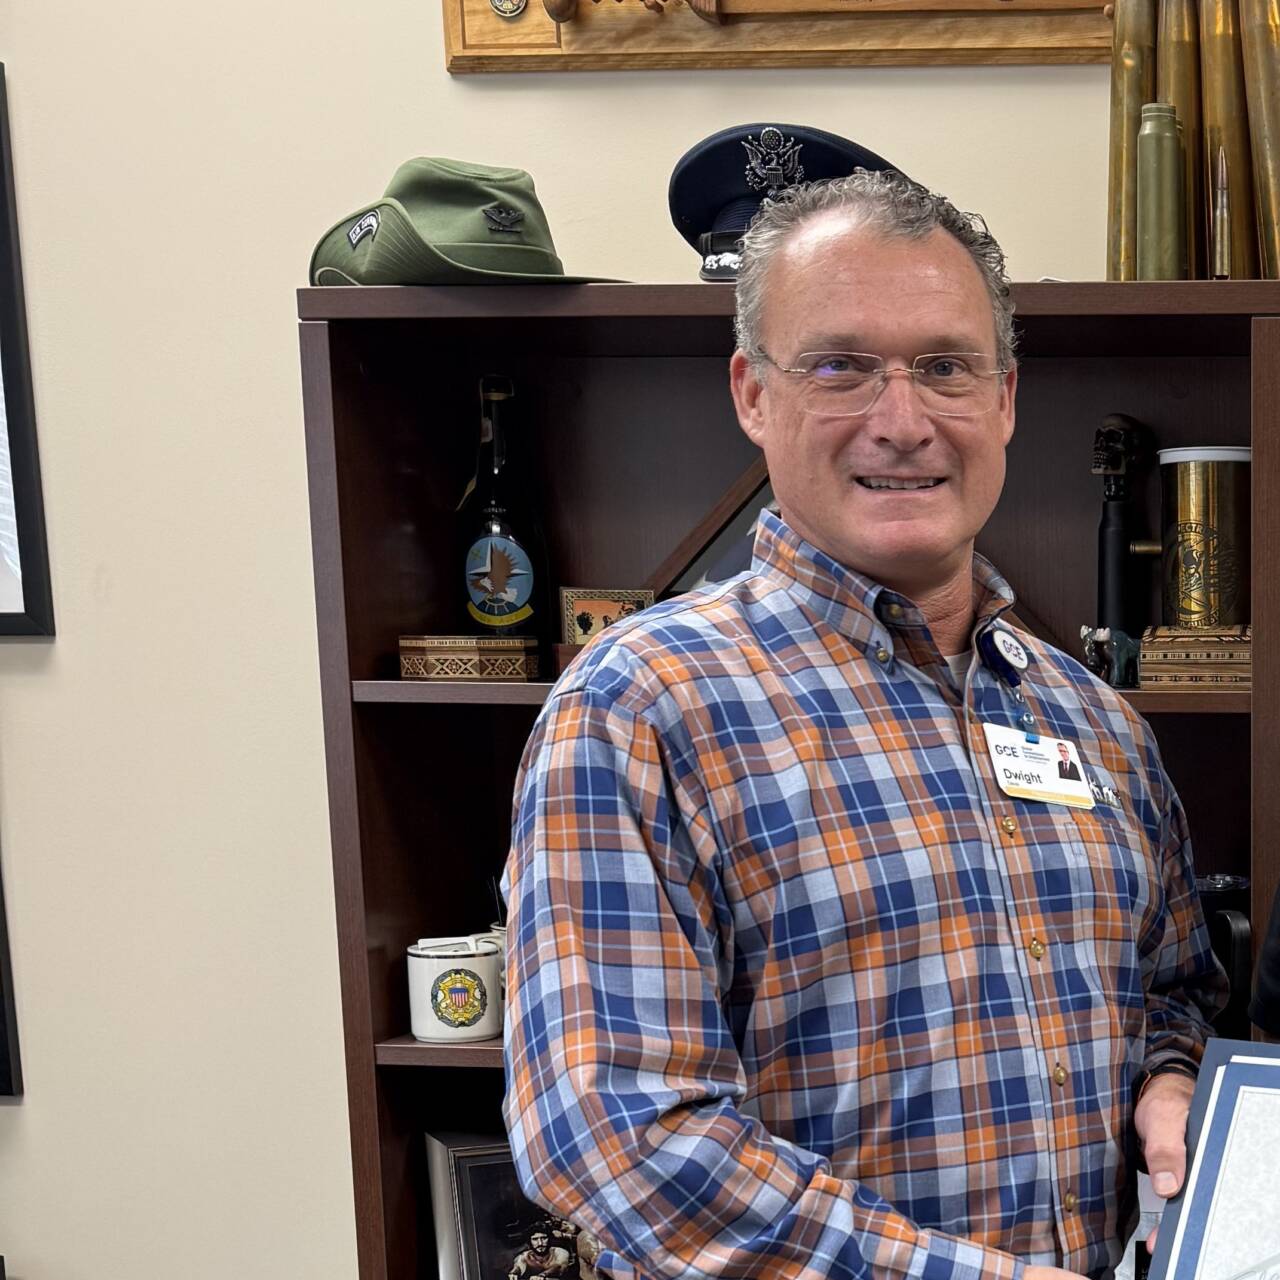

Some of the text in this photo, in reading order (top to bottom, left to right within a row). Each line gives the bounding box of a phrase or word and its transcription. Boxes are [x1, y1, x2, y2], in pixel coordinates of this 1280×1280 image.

[1002, 640, 1023, 661] GCE
[995, 745, 1019, 757] GCE
[1003, 768, 1042, 784] Dwight
